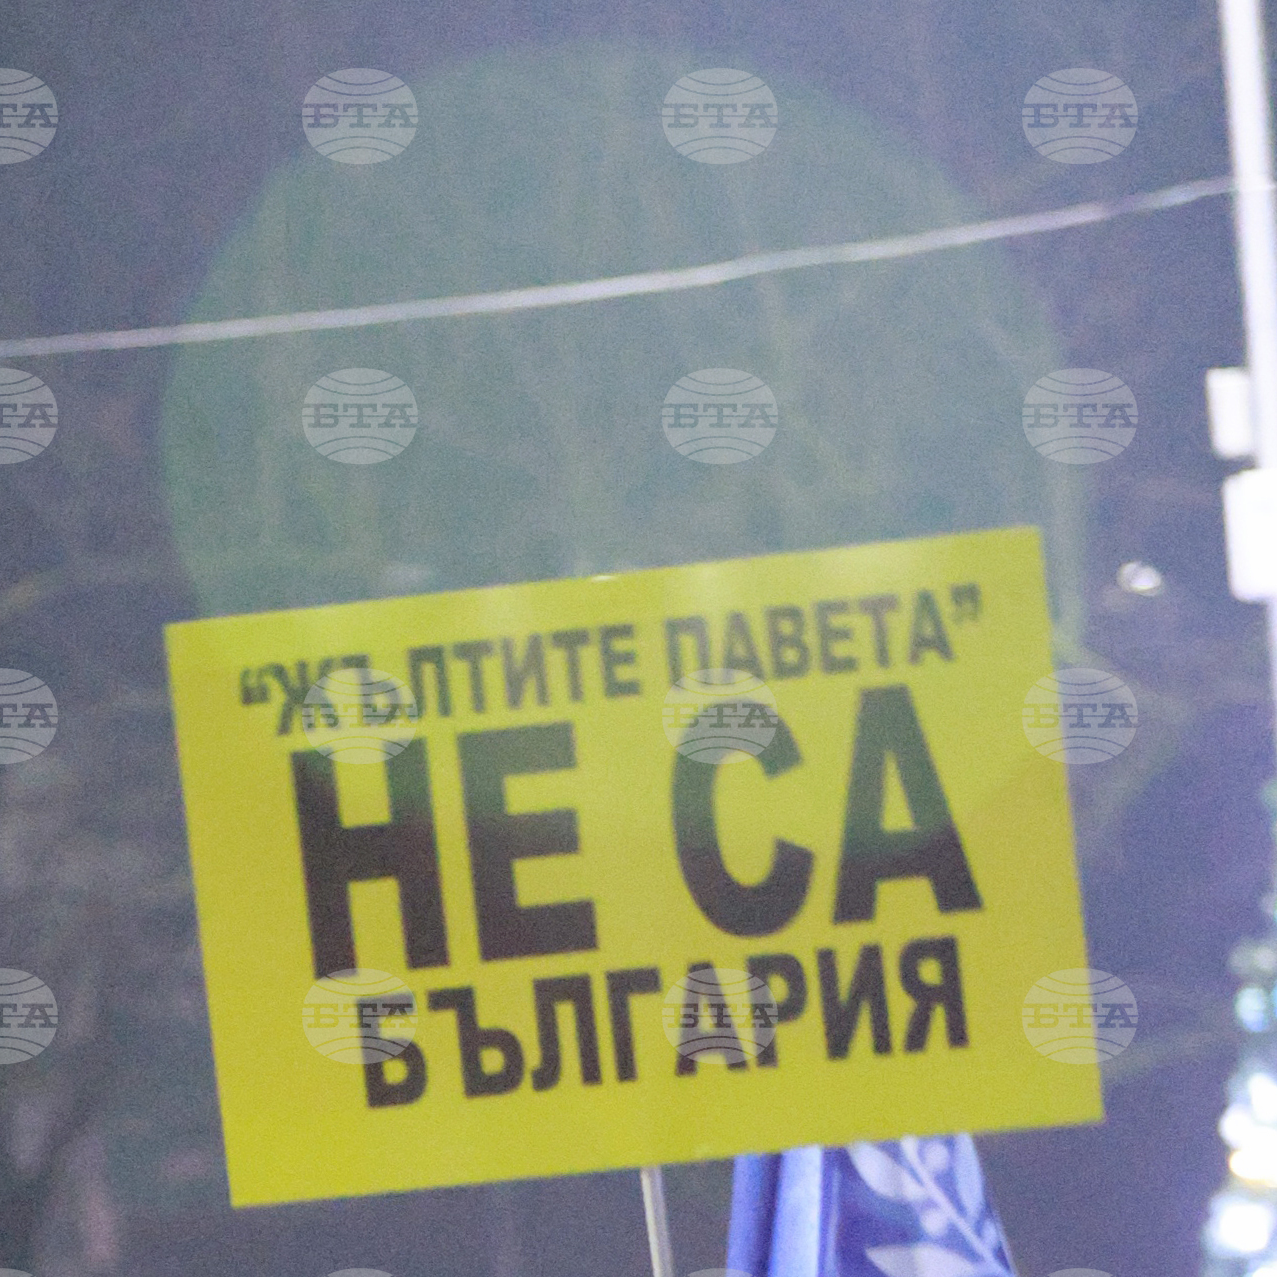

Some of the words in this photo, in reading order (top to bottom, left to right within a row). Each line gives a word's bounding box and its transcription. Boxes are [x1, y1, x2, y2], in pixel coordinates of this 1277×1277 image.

[289, 721, 599, 980] НЕ
[670, 684, 985, 938] СА
[356, 936, 969, 1108] БЪЛГАРИЯ
